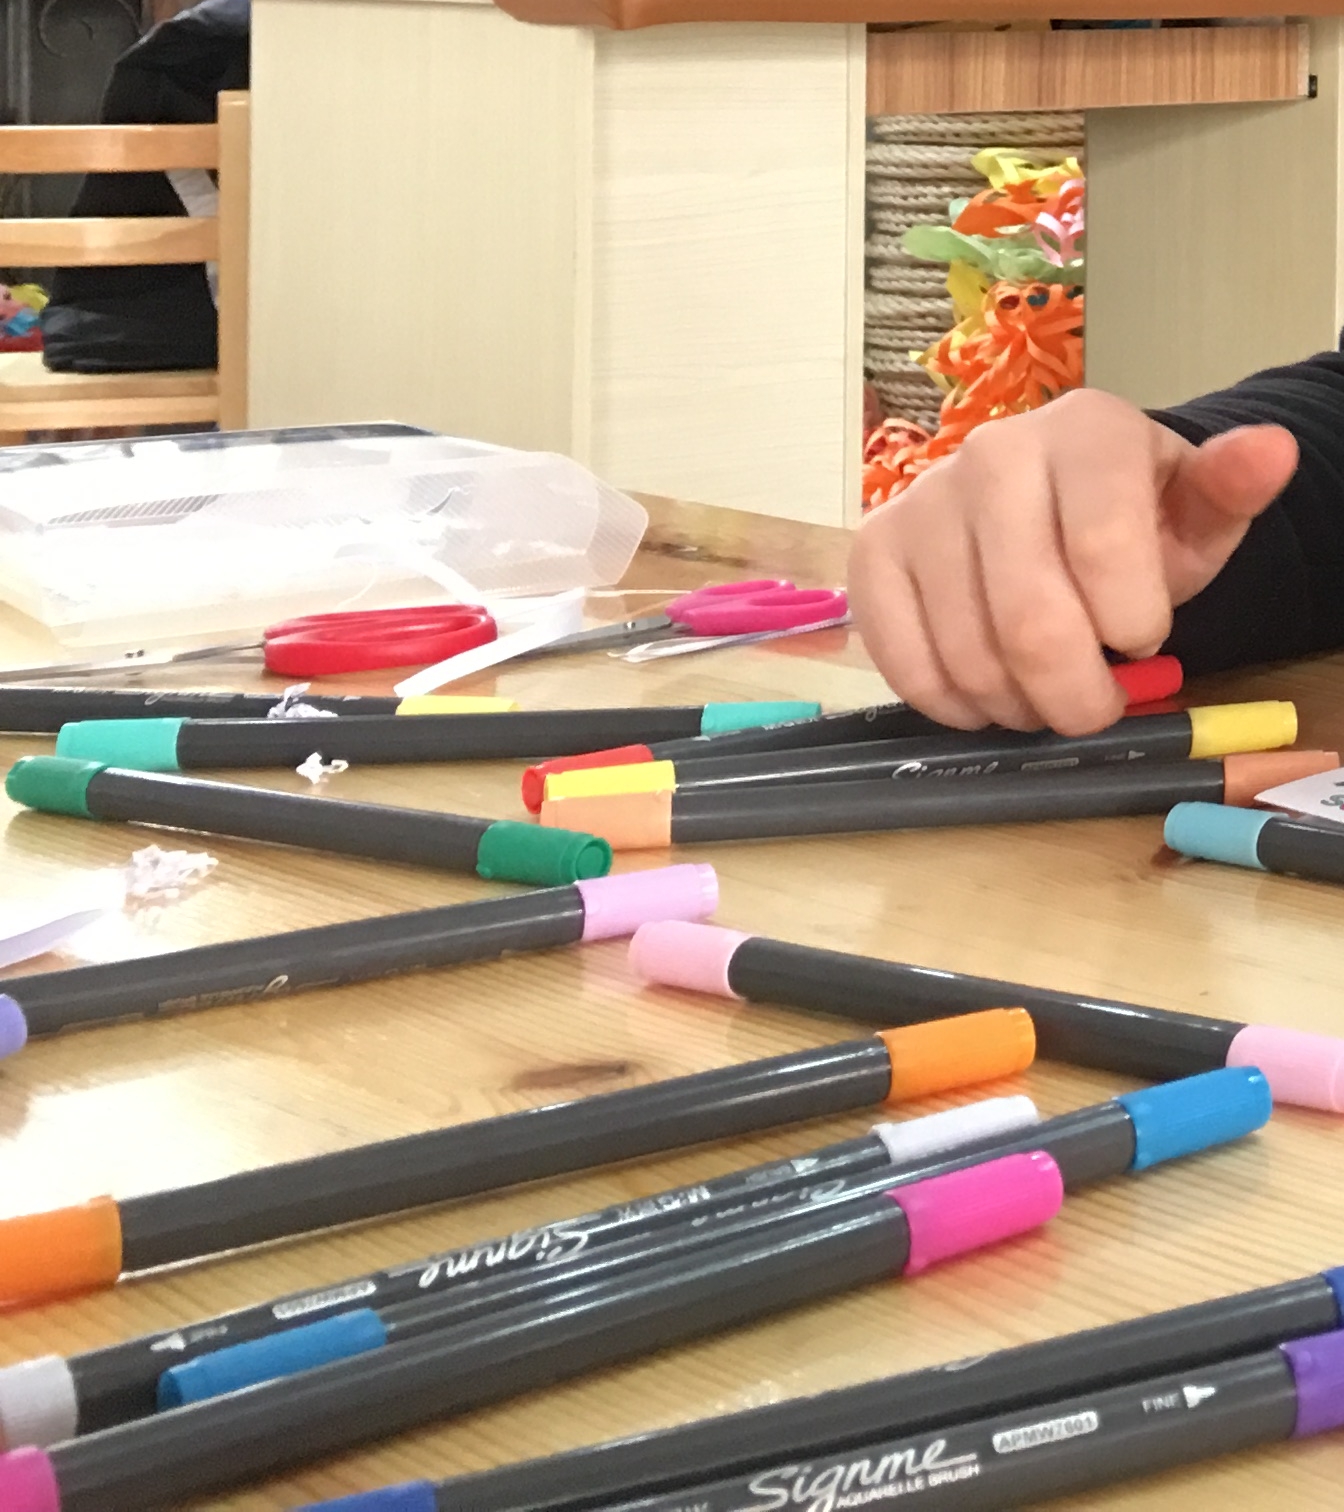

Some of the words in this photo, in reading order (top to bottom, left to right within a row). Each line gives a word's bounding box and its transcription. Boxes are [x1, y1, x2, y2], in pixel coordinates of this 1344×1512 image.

[732, 1438, 977, 1512] Signme
[1142, 1392, 1180, 1414] FINE
[927, 1463, 981, 1488] BRUSH
